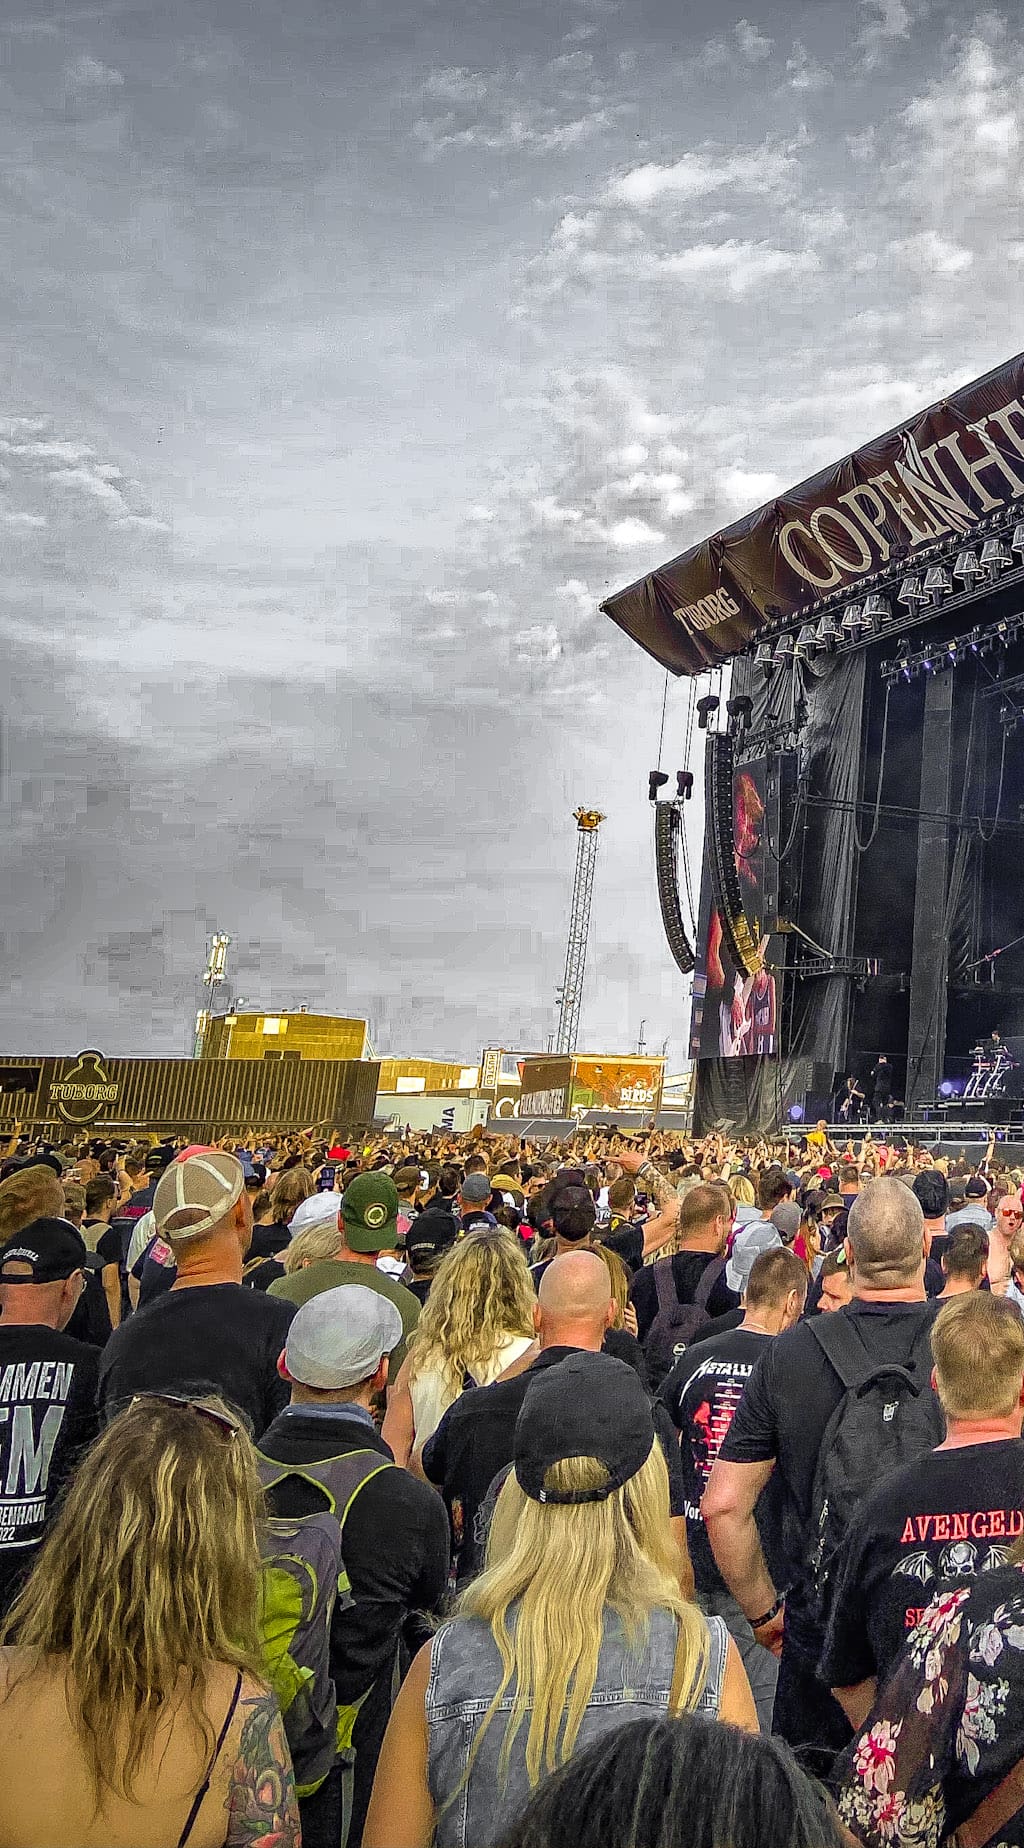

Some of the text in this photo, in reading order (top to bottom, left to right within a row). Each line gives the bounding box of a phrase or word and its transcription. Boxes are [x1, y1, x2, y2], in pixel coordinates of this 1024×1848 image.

[673, 587, 740, 635] TUBORG
[50, 1083, 118, 1101] TUBORG
[900, 1510, 1024, 1543] AVENGED
